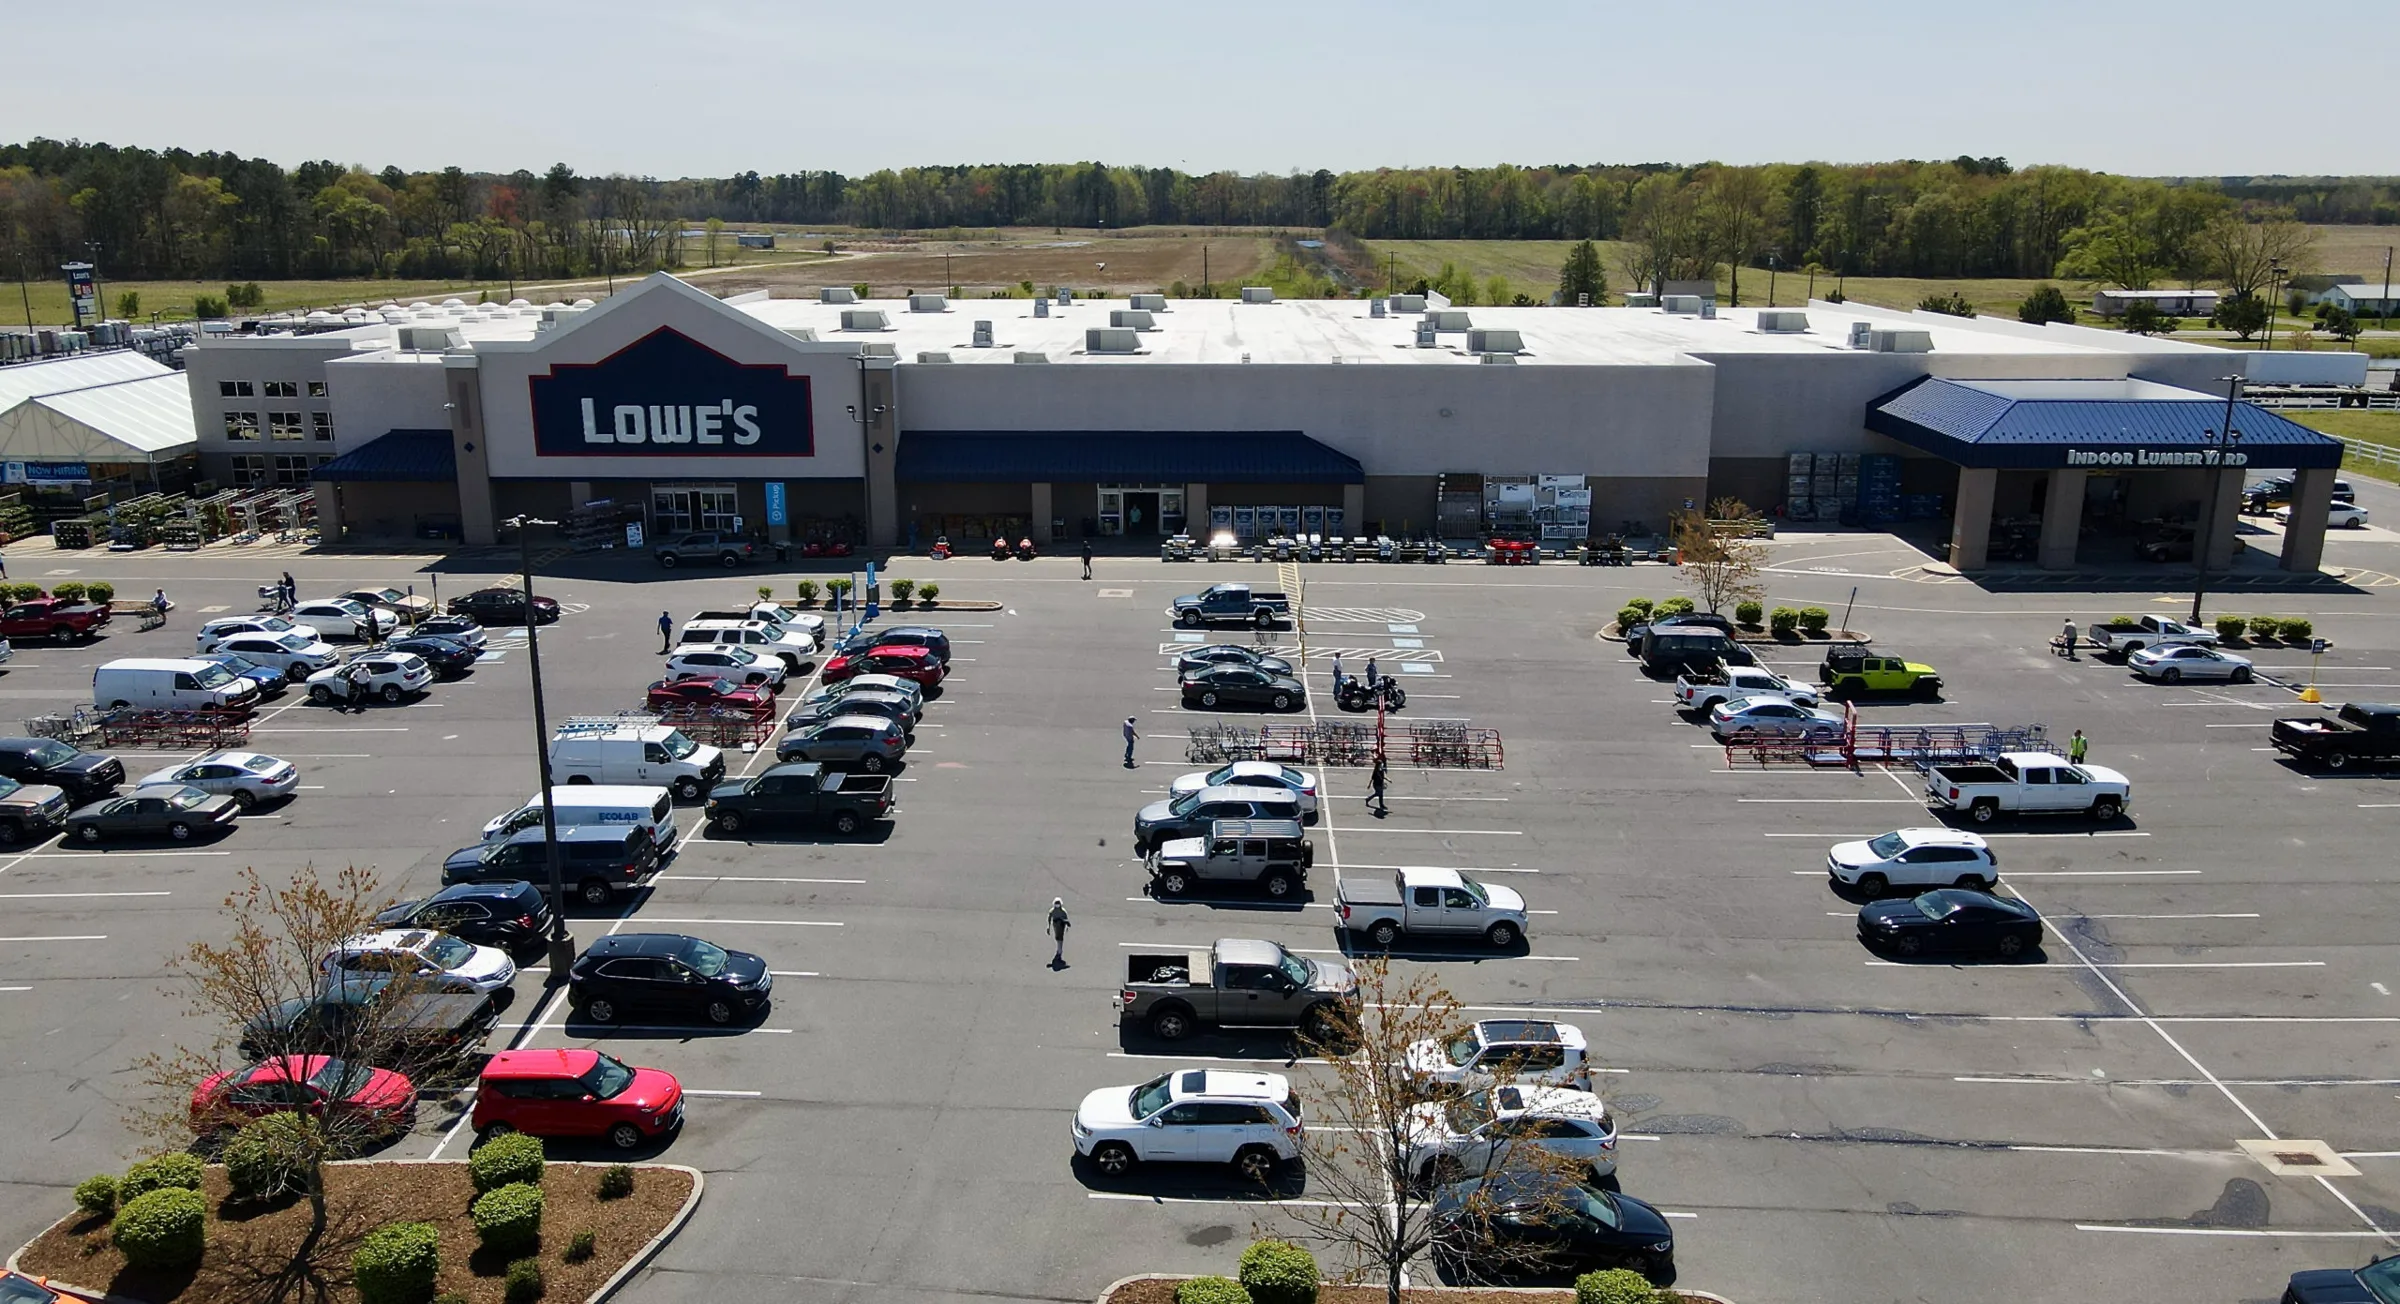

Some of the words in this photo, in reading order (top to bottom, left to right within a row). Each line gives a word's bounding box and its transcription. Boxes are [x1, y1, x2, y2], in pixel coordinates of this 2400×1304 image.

[581, 398, 761, 445] LOWE'S
[2067, 450, 2133, 465] INDOOR
[28, 465, 51, 475] NOW
[53, 466, 88, 475] HIRING
[772, 484, 780, 510] Pickup
[598, 812, 639, 821] ECOLAB
